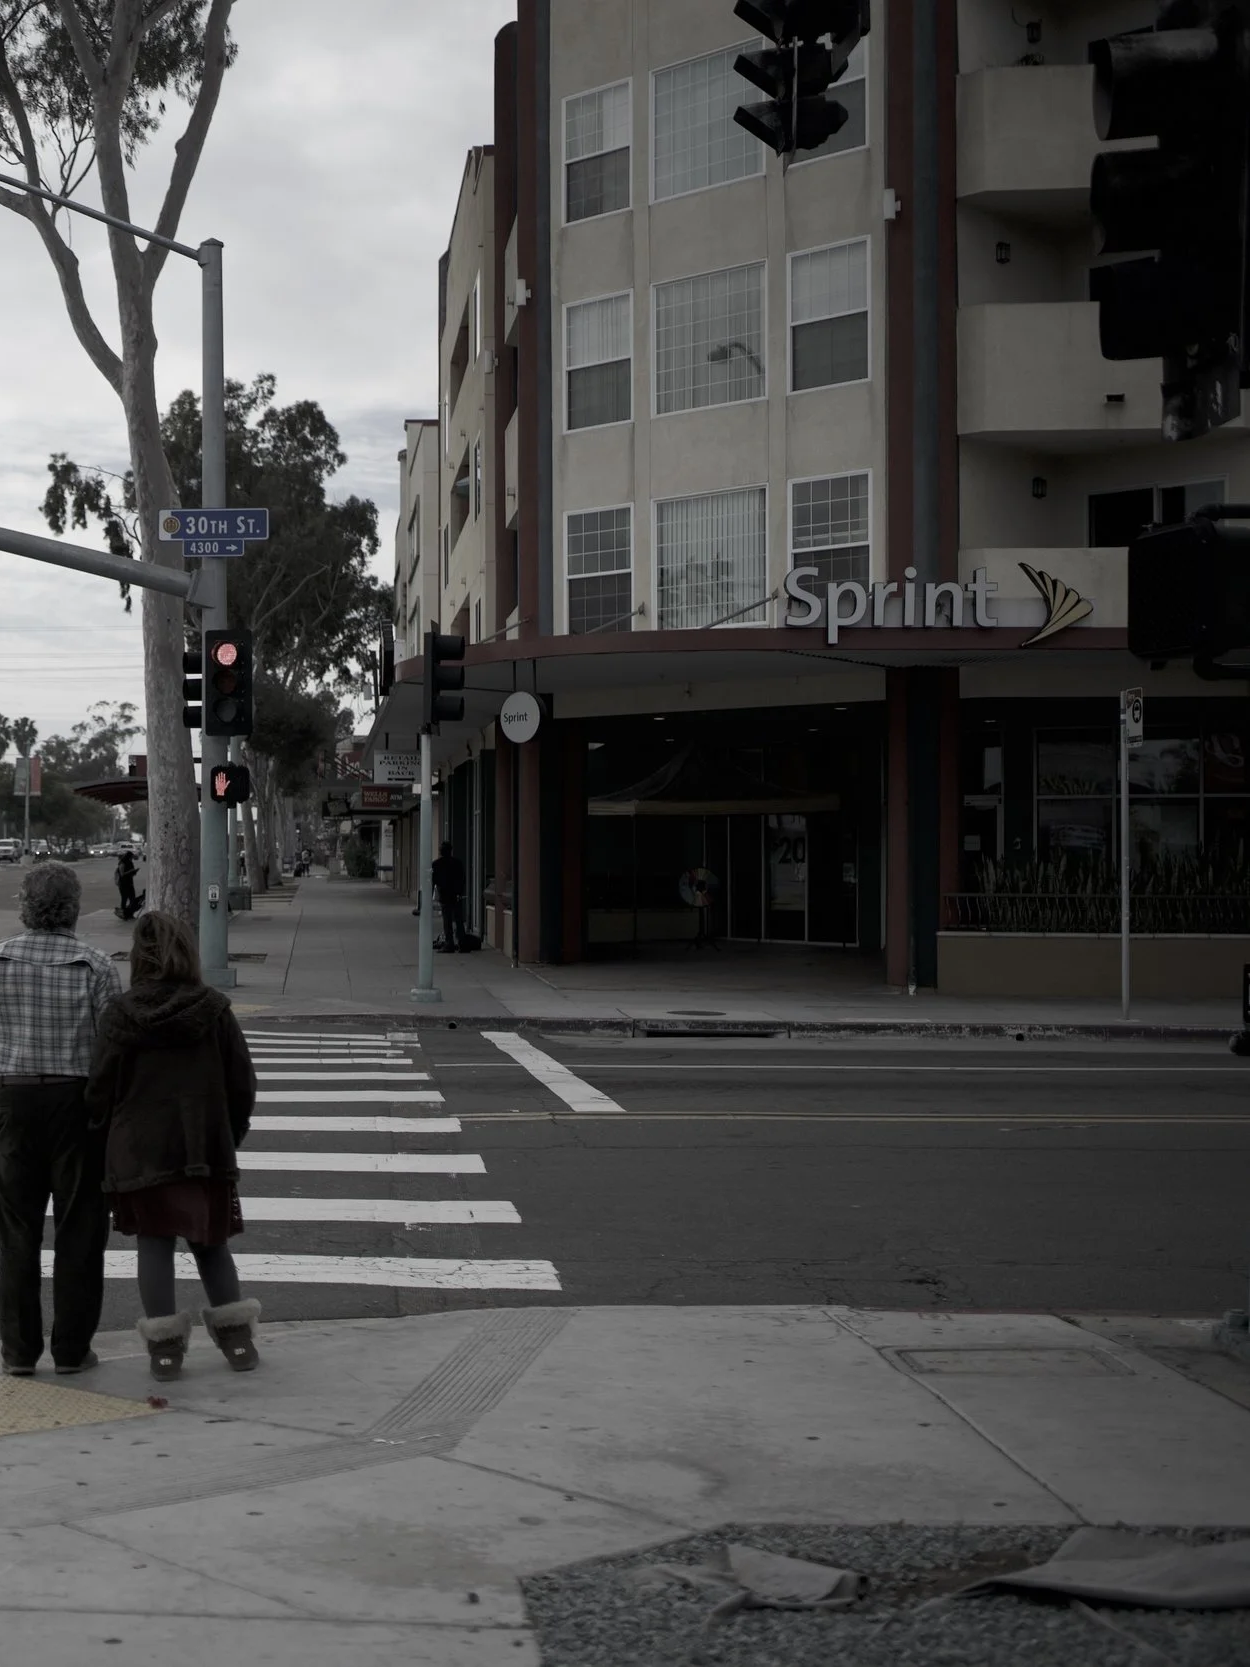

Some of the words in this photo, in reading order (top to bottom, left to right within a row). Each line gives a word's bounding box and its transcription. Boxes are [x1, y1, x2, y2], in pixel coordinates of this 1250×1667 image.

[186, 516, 228, 534] 30TH
[236, 516, 261, 534] ST.
[190, 542, 219, 553] 4300
[784, 566, 998, 646] Sprint
[503, 711, 528, 724] Sprint
